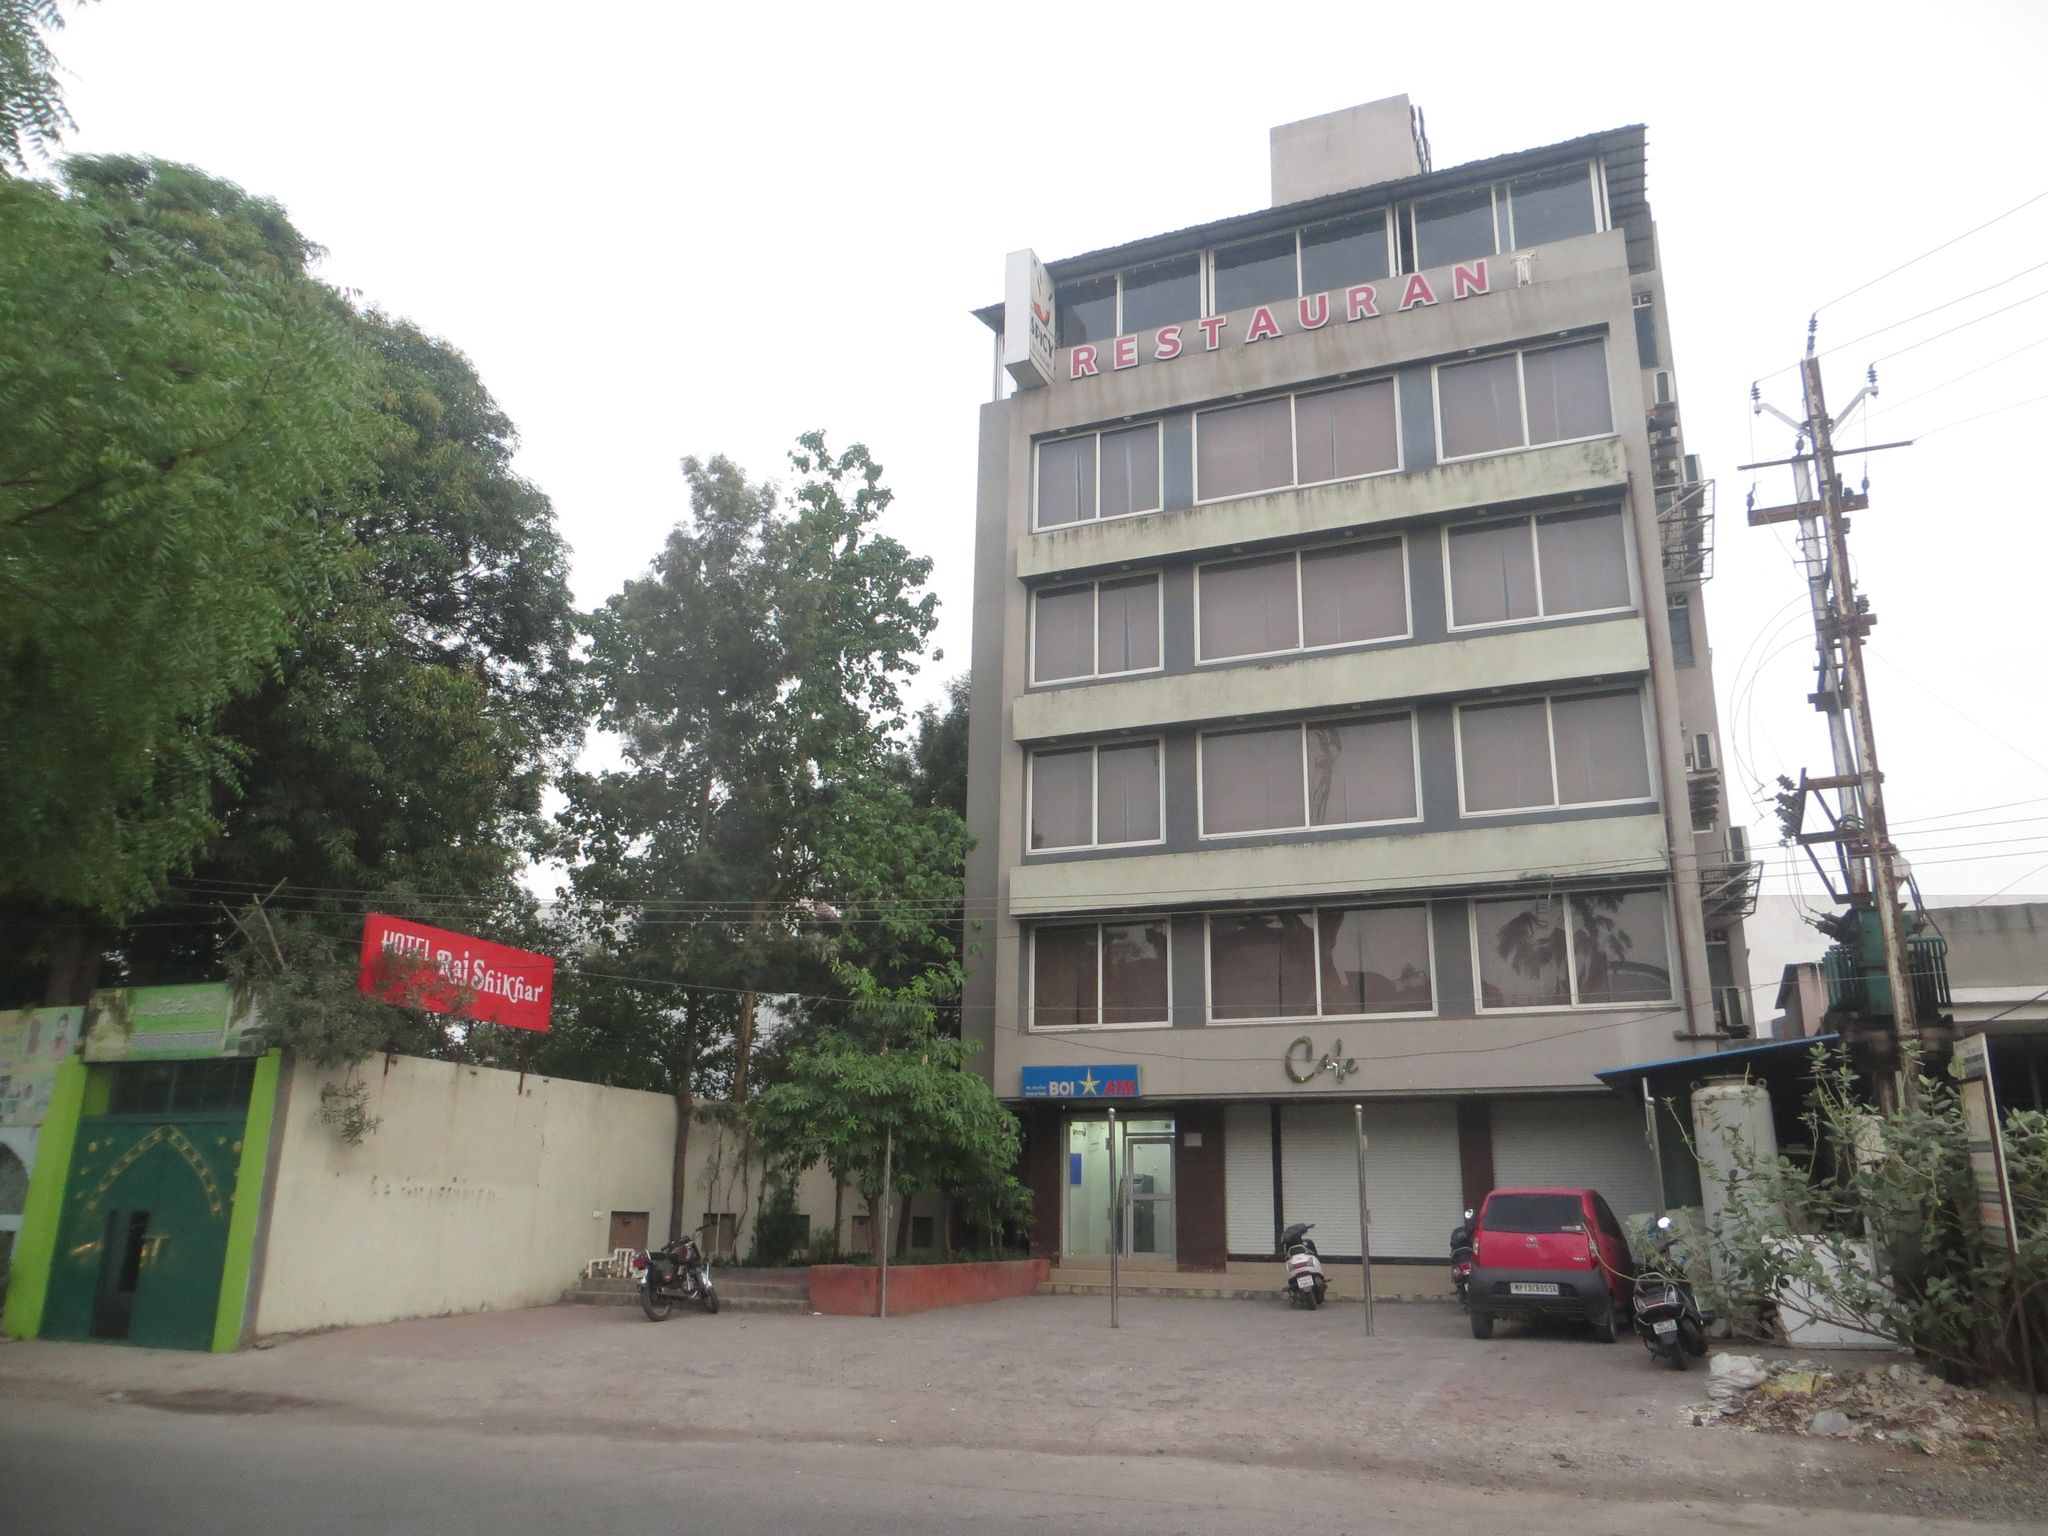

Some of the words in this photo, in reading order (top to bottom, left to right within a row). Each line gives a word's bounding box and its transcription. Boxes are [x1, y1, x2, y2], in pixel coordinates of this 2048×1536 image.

[1070, 250, 1538, 380] RESTAURANT
[436, 949, 470, 987] Raj
[1049, 1081, 1075, 1097] BOI
[1102, 1079, 1137, 1097] ATM
